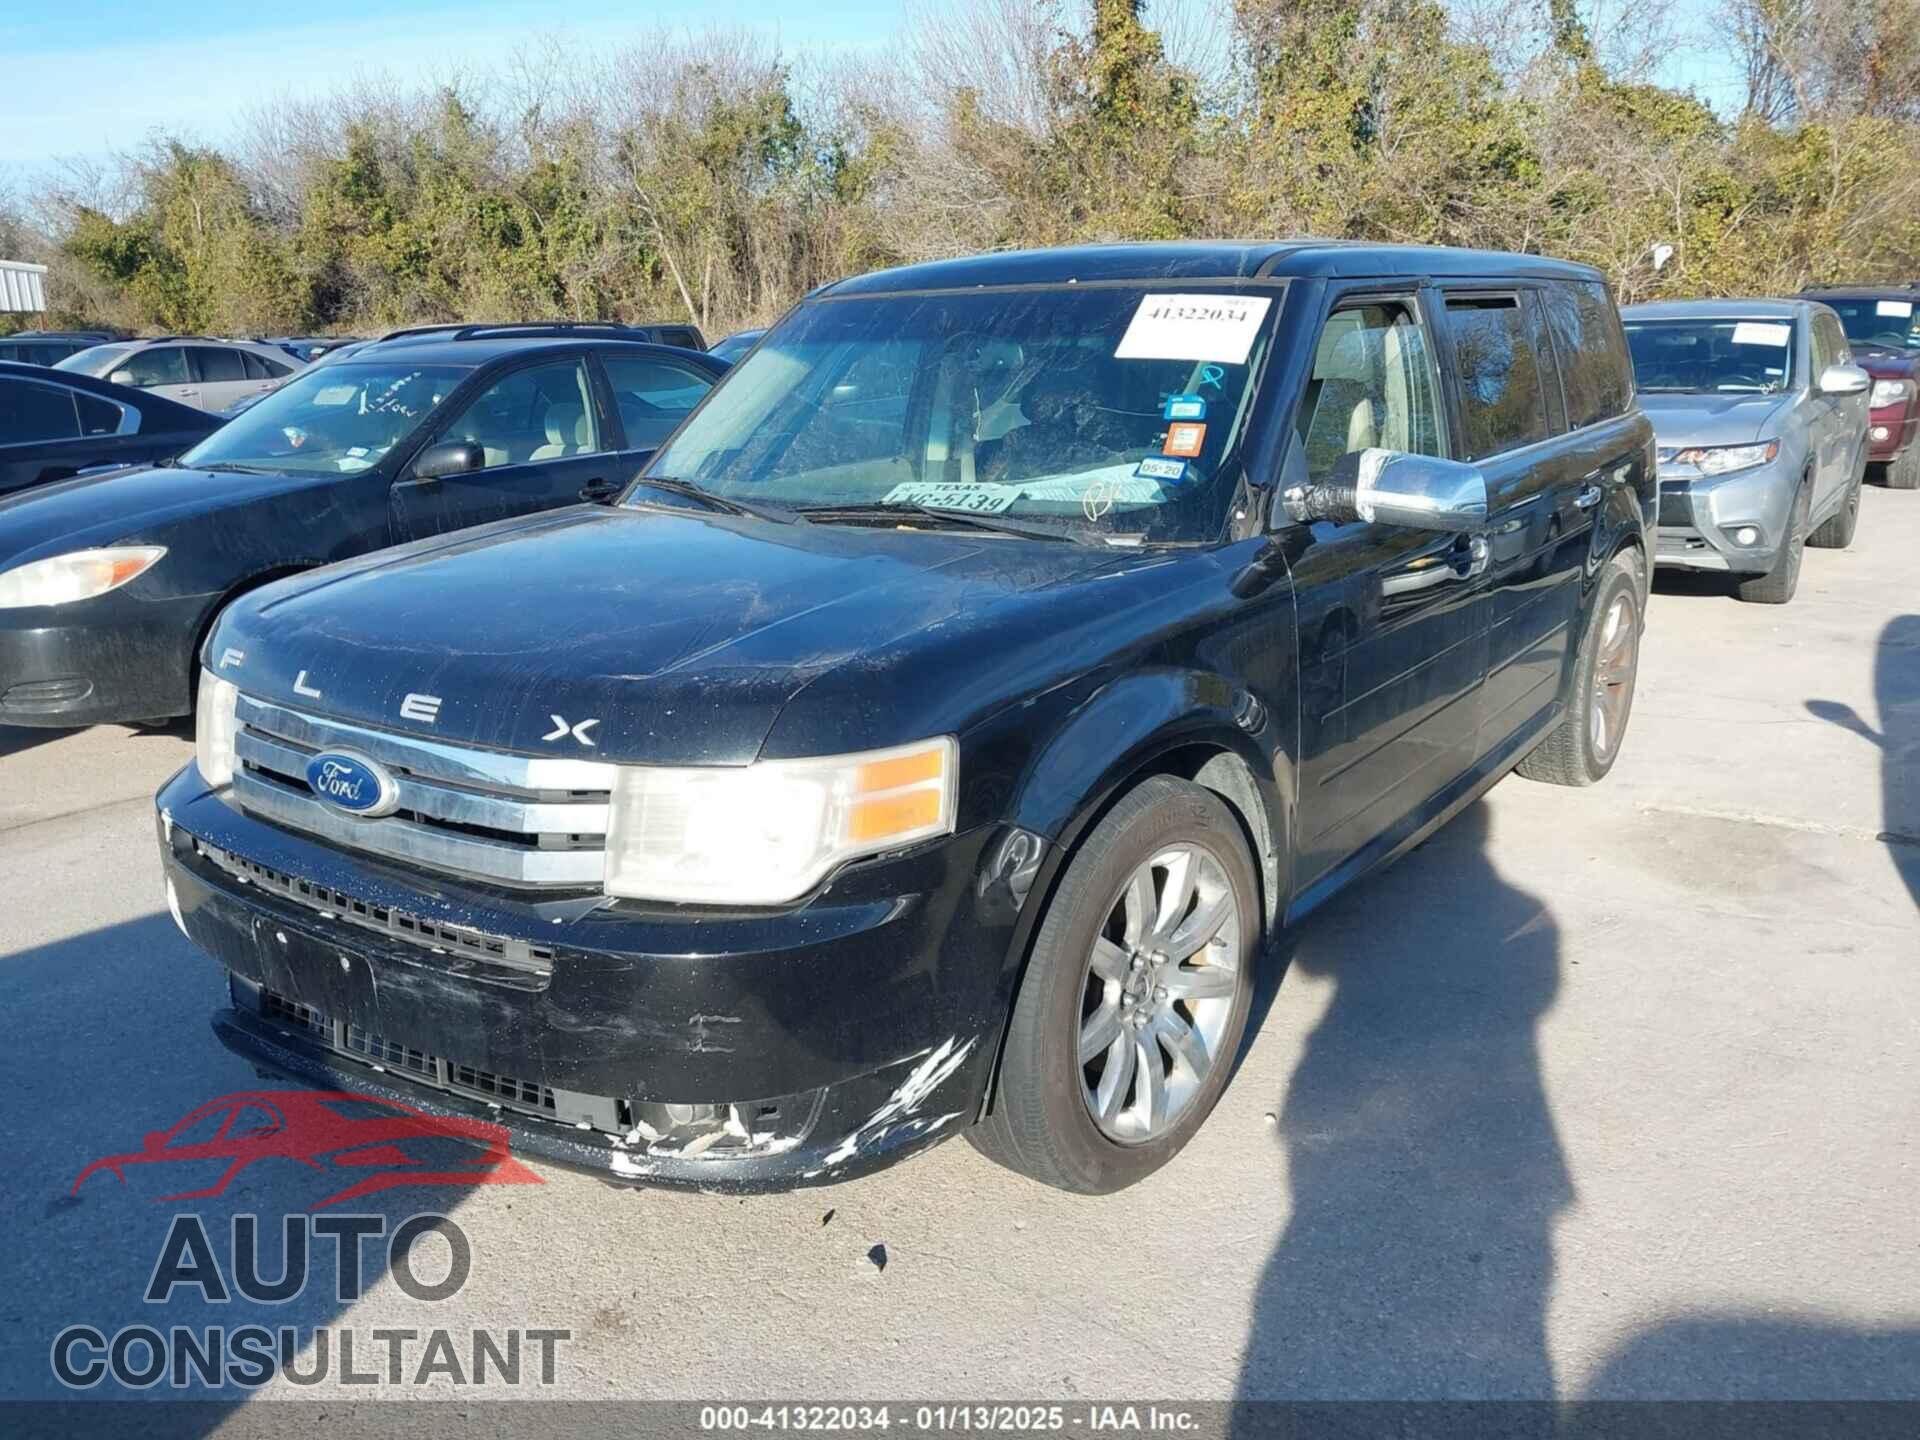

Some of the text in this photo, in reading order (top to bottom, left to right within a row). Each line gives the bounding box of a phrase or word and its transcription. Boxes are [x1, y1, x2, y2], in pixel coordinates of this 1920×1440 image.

[1146, 307, 1248, 322] 41322034
[934, 484, 982, 492] TEXAS
[317, 761, 363, 800] Ford
